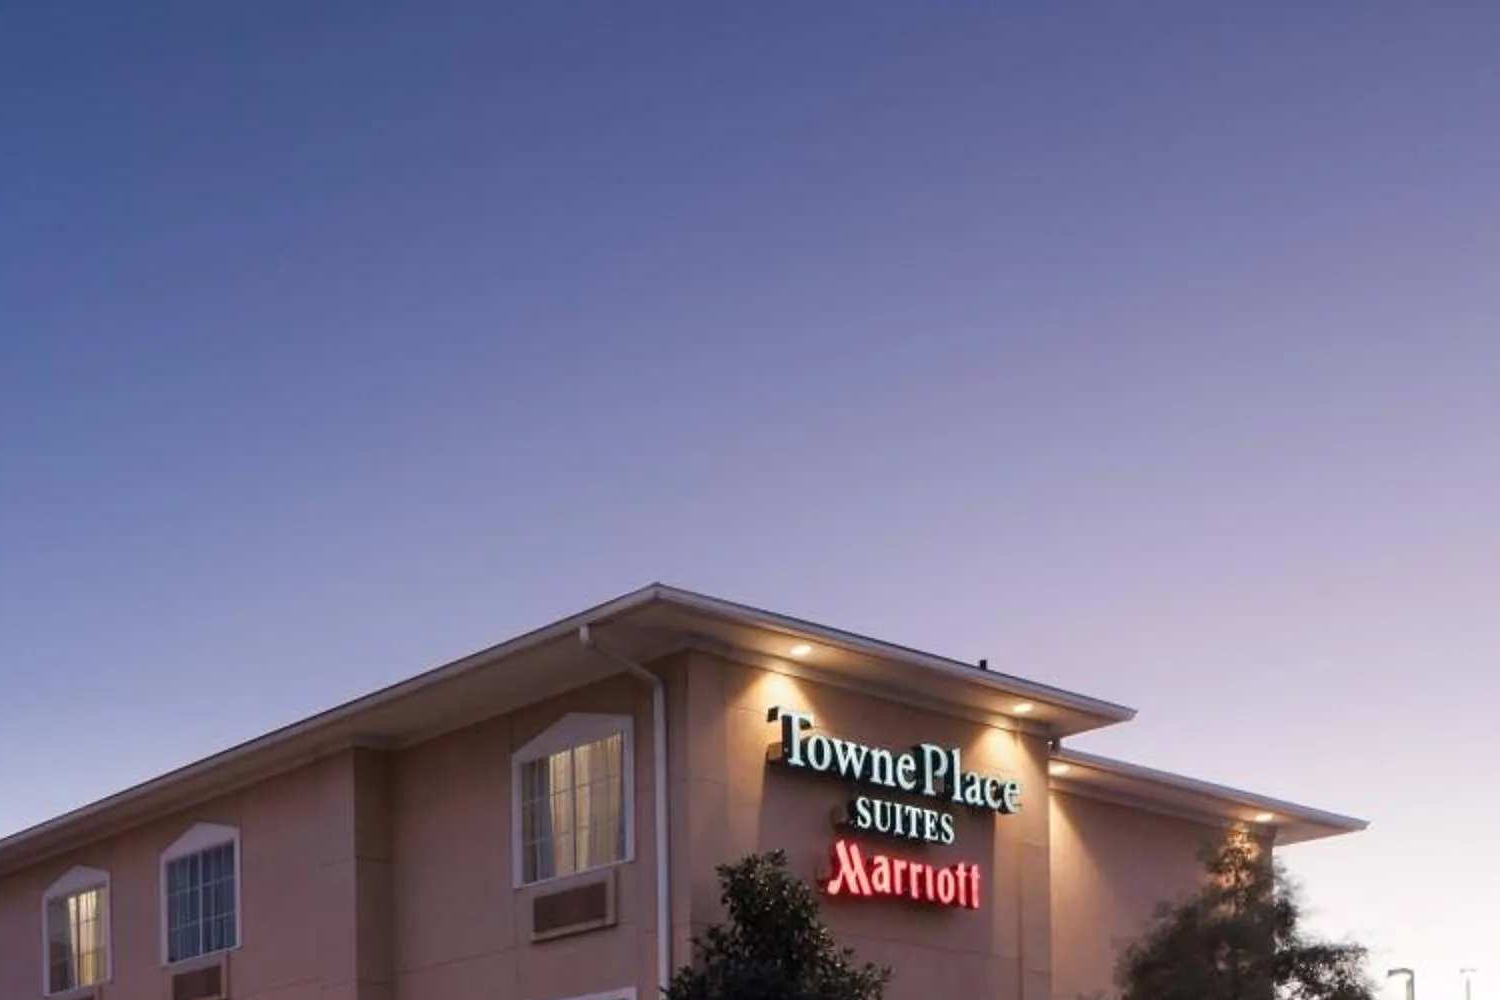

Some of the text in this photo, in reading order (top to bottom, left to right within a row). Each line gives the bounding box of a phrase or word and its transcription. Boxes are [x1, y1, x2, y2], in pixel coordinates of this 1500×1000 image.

[768, 705, 1022, 814] TownePlace
[855, 796, 956, 845] SUITES
[827, 839, 981, 909] Marriott
